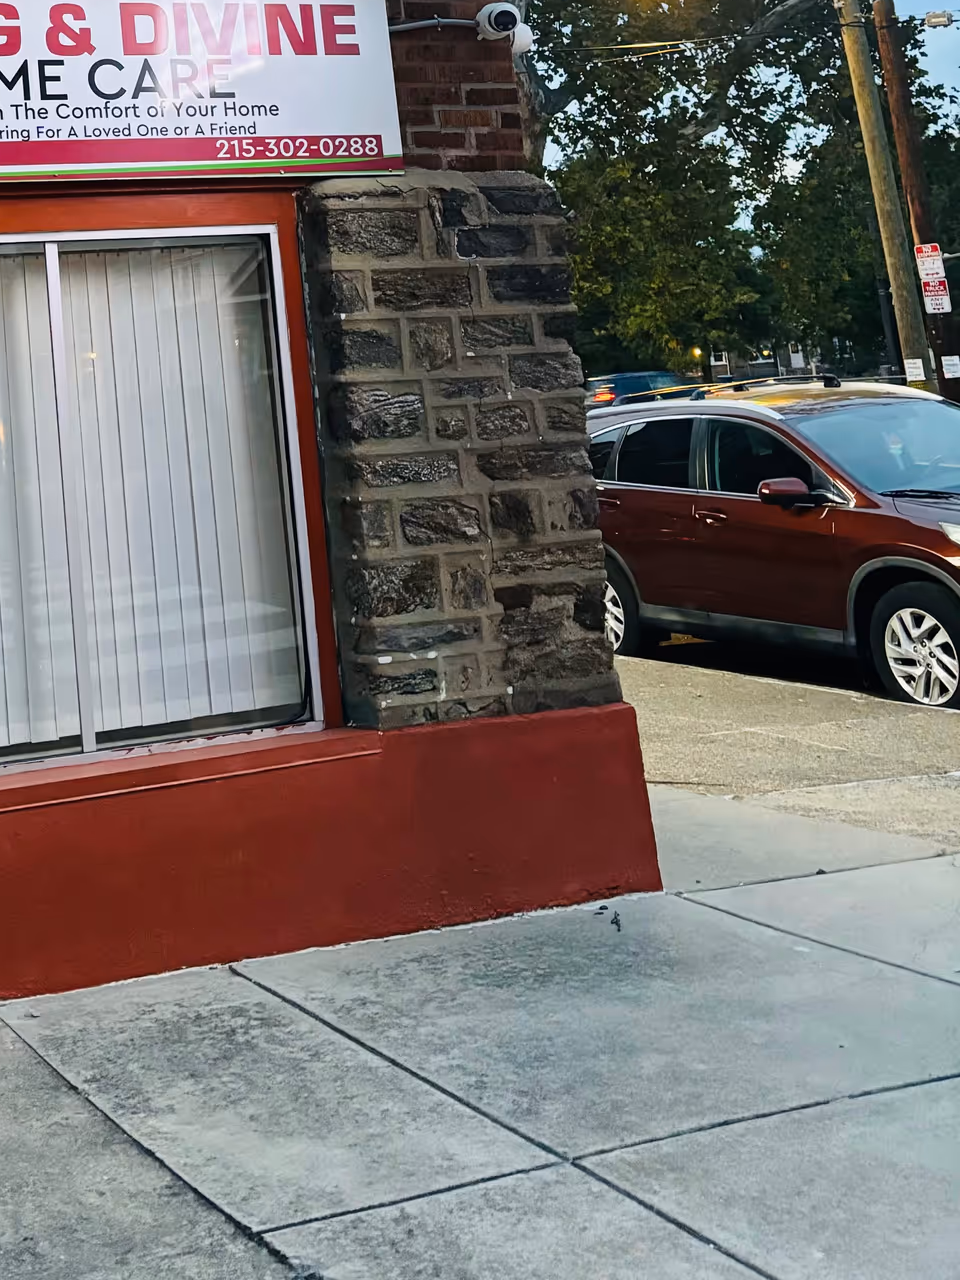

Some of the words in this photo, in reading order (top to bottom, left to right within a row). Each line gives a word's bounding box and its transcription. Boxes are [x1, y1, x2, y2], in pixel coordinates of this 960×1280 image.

[45, 3, 96, 56] &
[119, 2, 360, 55] DIVINE
[88, 58, 235, 100] CARE
[10, 103, 49, 120] The
[56, 101, 140, 119] Comfort
[147, 100, 166, 118] of
[172, 102, 217, 117] Your
[224, 101, 279, 117] Home
[36, 126, 61, 139] For
[67, 125, 78, 138] A
[84, 123, 131, 137] Loved
[137, 124, 168, 136] One
[174, 126, 189, 136] or
[194, 123, 205, 135] A
[210, 122, 257, 135] Friend
[216, 137, 379, 158] 215-302-0288
